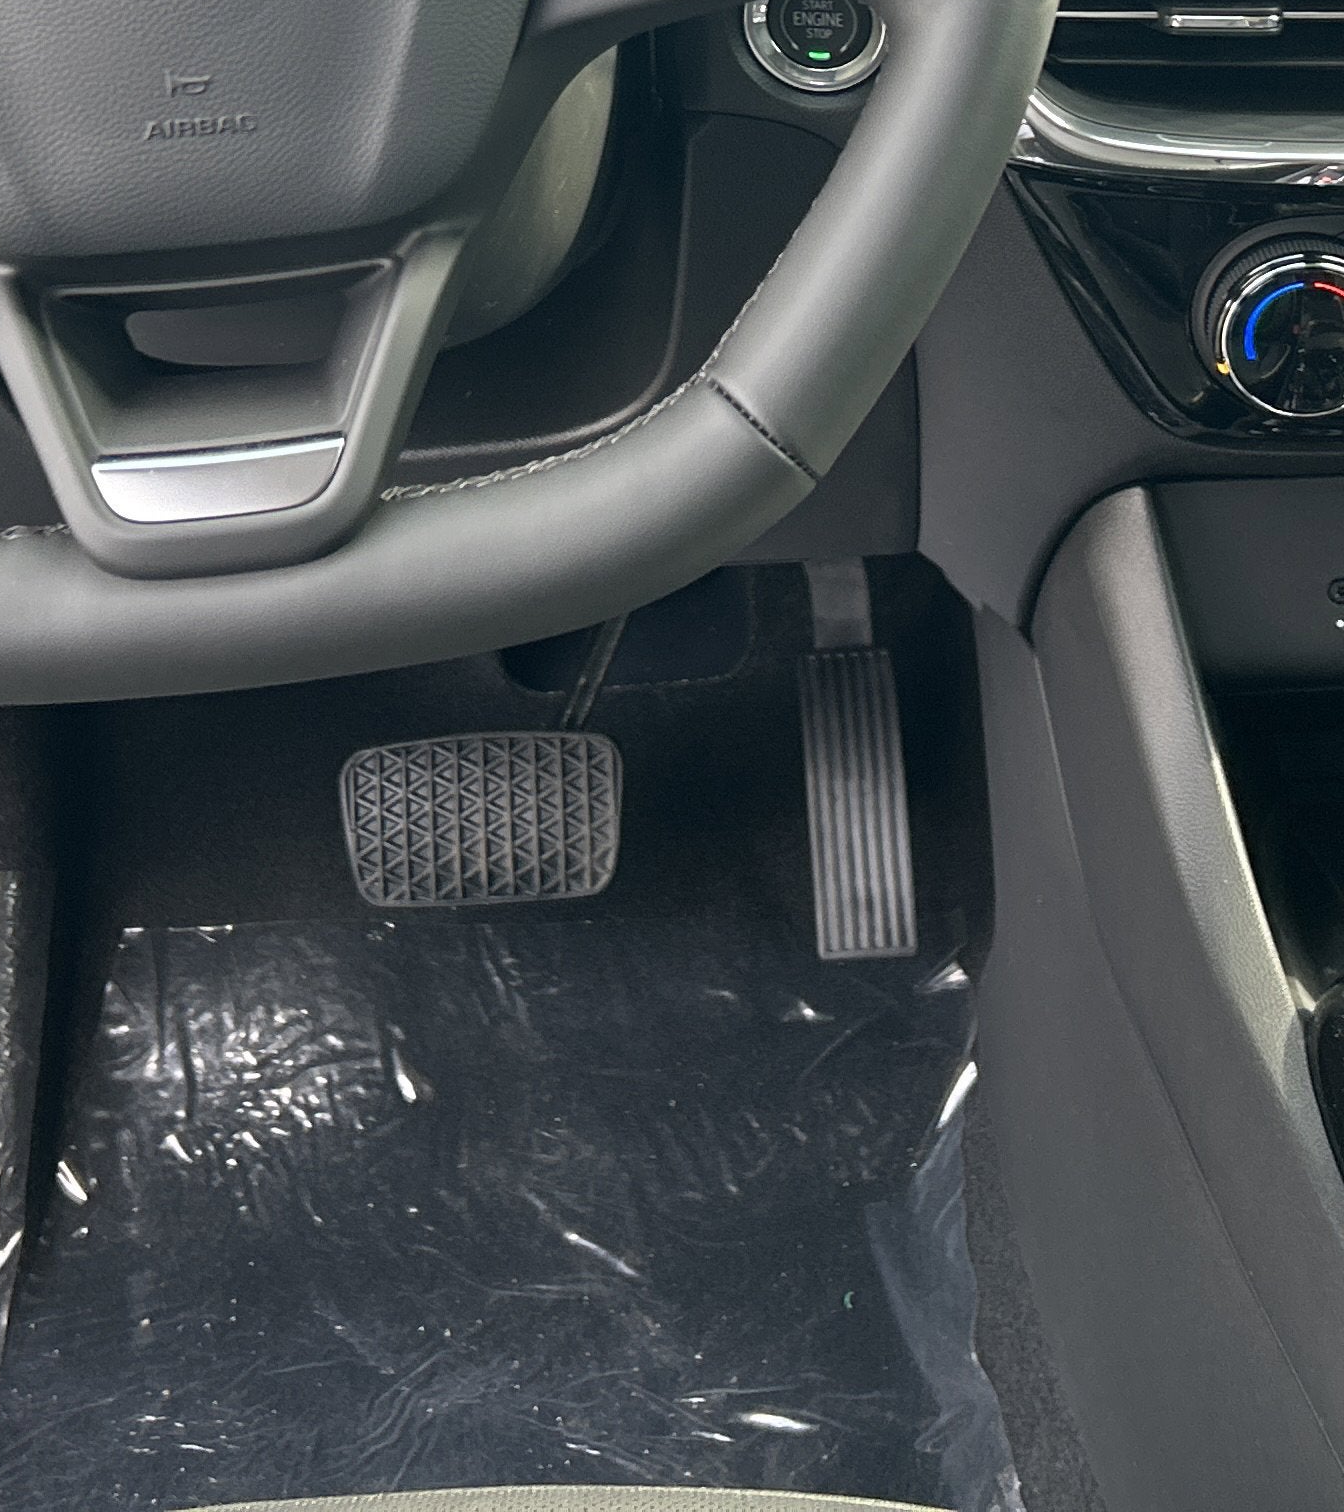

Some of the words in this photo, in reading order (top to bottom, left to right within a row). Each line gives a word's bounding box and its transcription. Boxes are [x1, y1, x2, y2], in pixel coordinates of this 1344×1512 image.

[801, 0, 834, 11] START
[792, 11, 845, 28] ENGINE
[805, 27, 834, 39] STOP
[143, 113, 258, 141] AIRBAG
